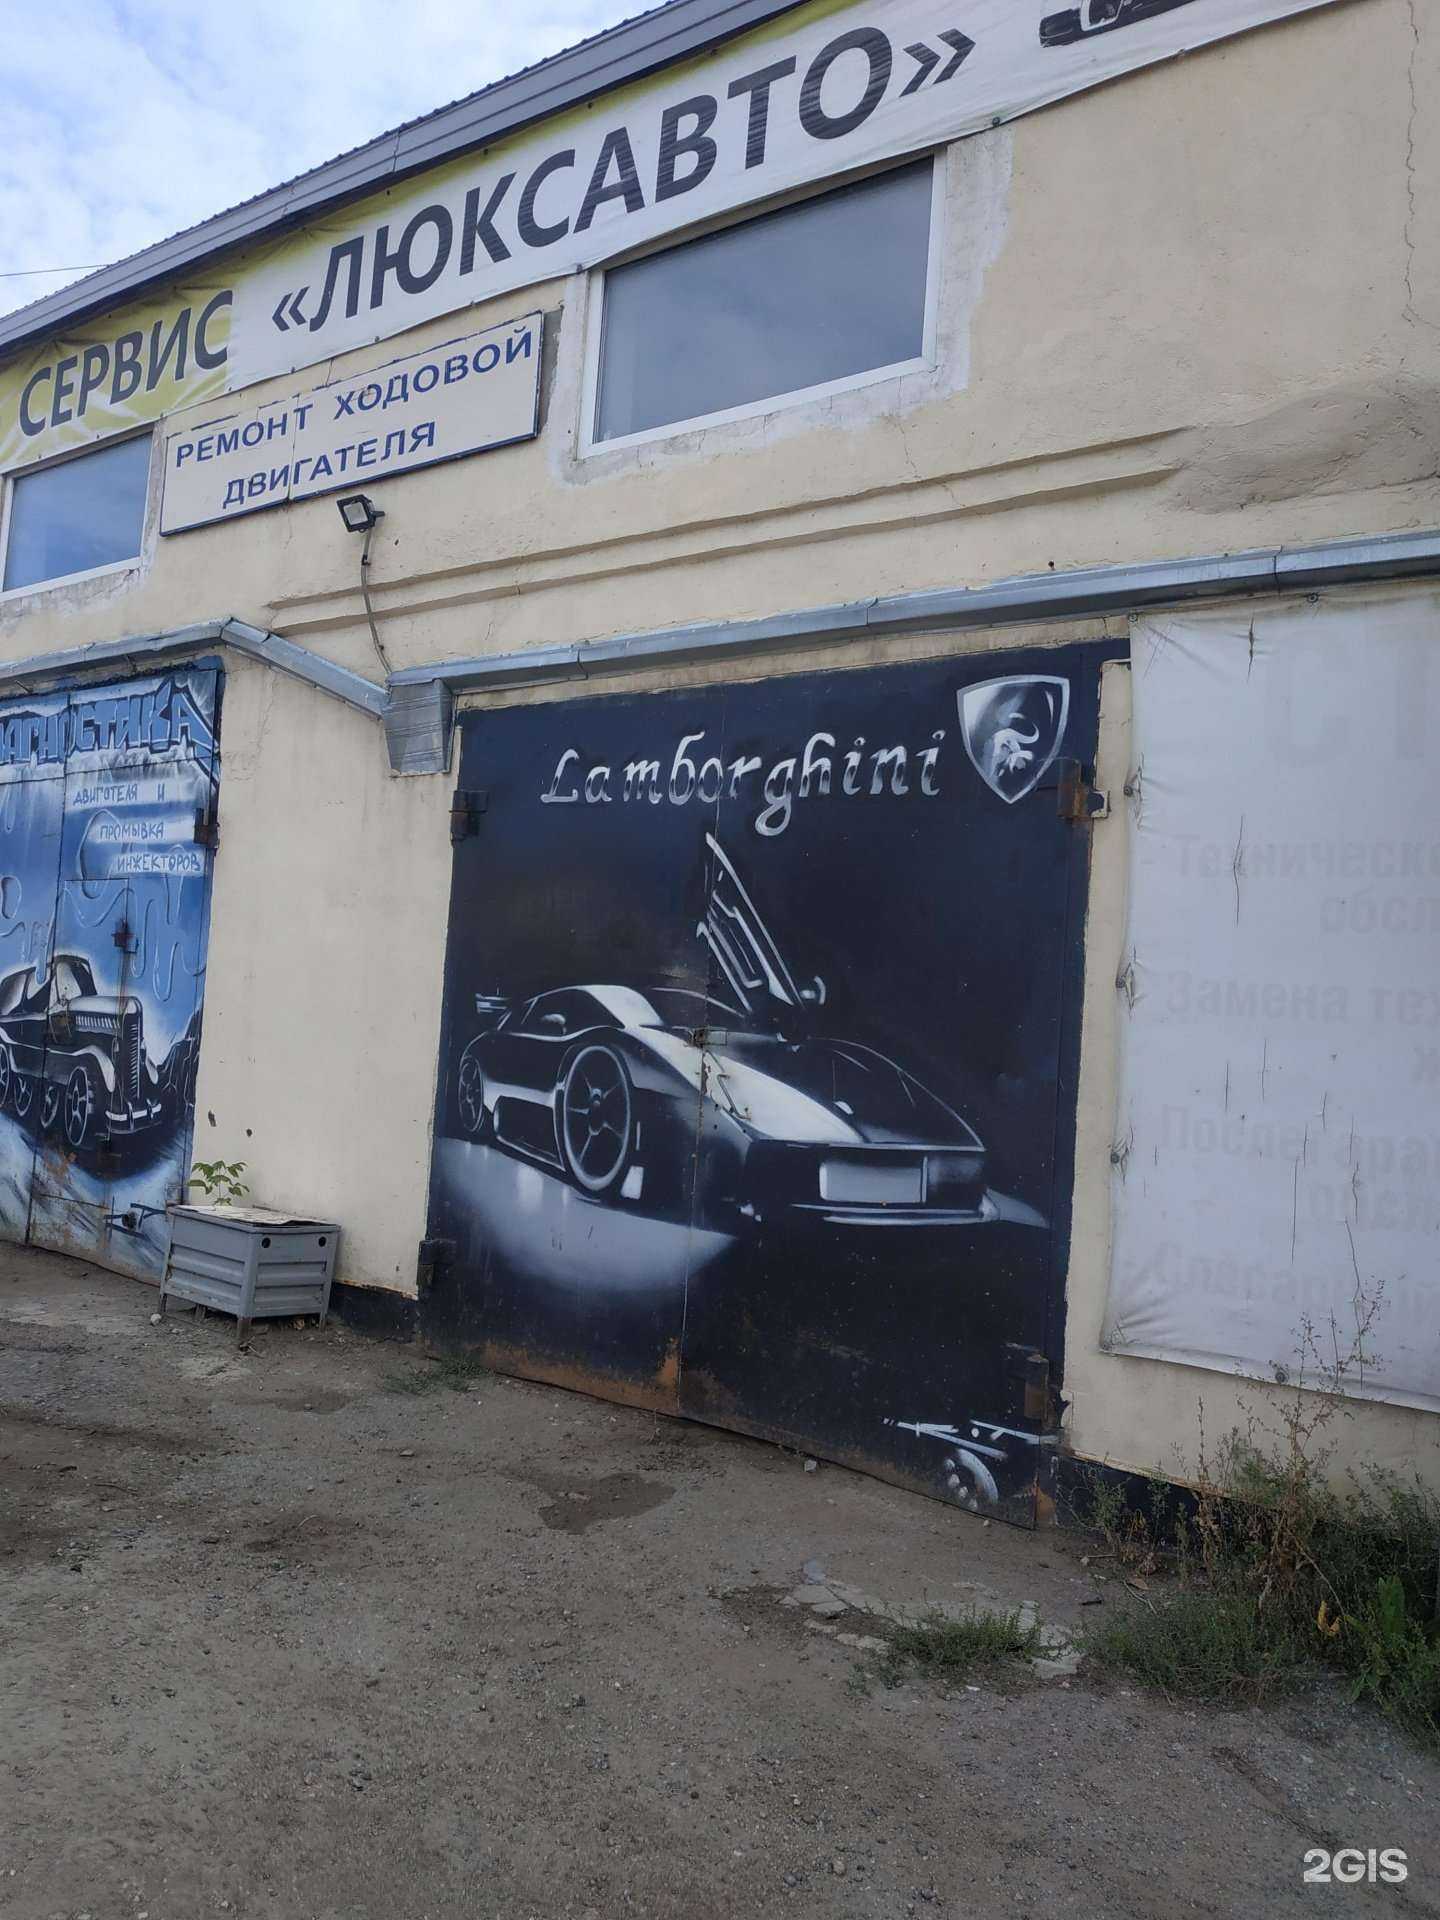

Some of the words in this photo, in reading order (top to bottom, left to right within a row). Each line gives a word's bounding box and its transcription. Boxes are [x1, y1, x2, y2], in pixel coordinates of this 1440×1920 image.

[19, 288, 234, 437] СЕРВИС
[270, 26, 977, 333] «ЛЮКСАВТО»
[174, 403, 314, 469] РЕМОНТ
[333, 325, 534, 422] ХОДОВОЙ
[222, 421, 437, 509] ДВИГАТЕЛЯ
[540, 730, 946, 836] Lamborghini
[100, 822, 165, 841] ПРОМЫВКА
[116, 853, 202, 873] ИНЖЕКТОРОВ
[1166, 969, 1350, 1025] Замена
